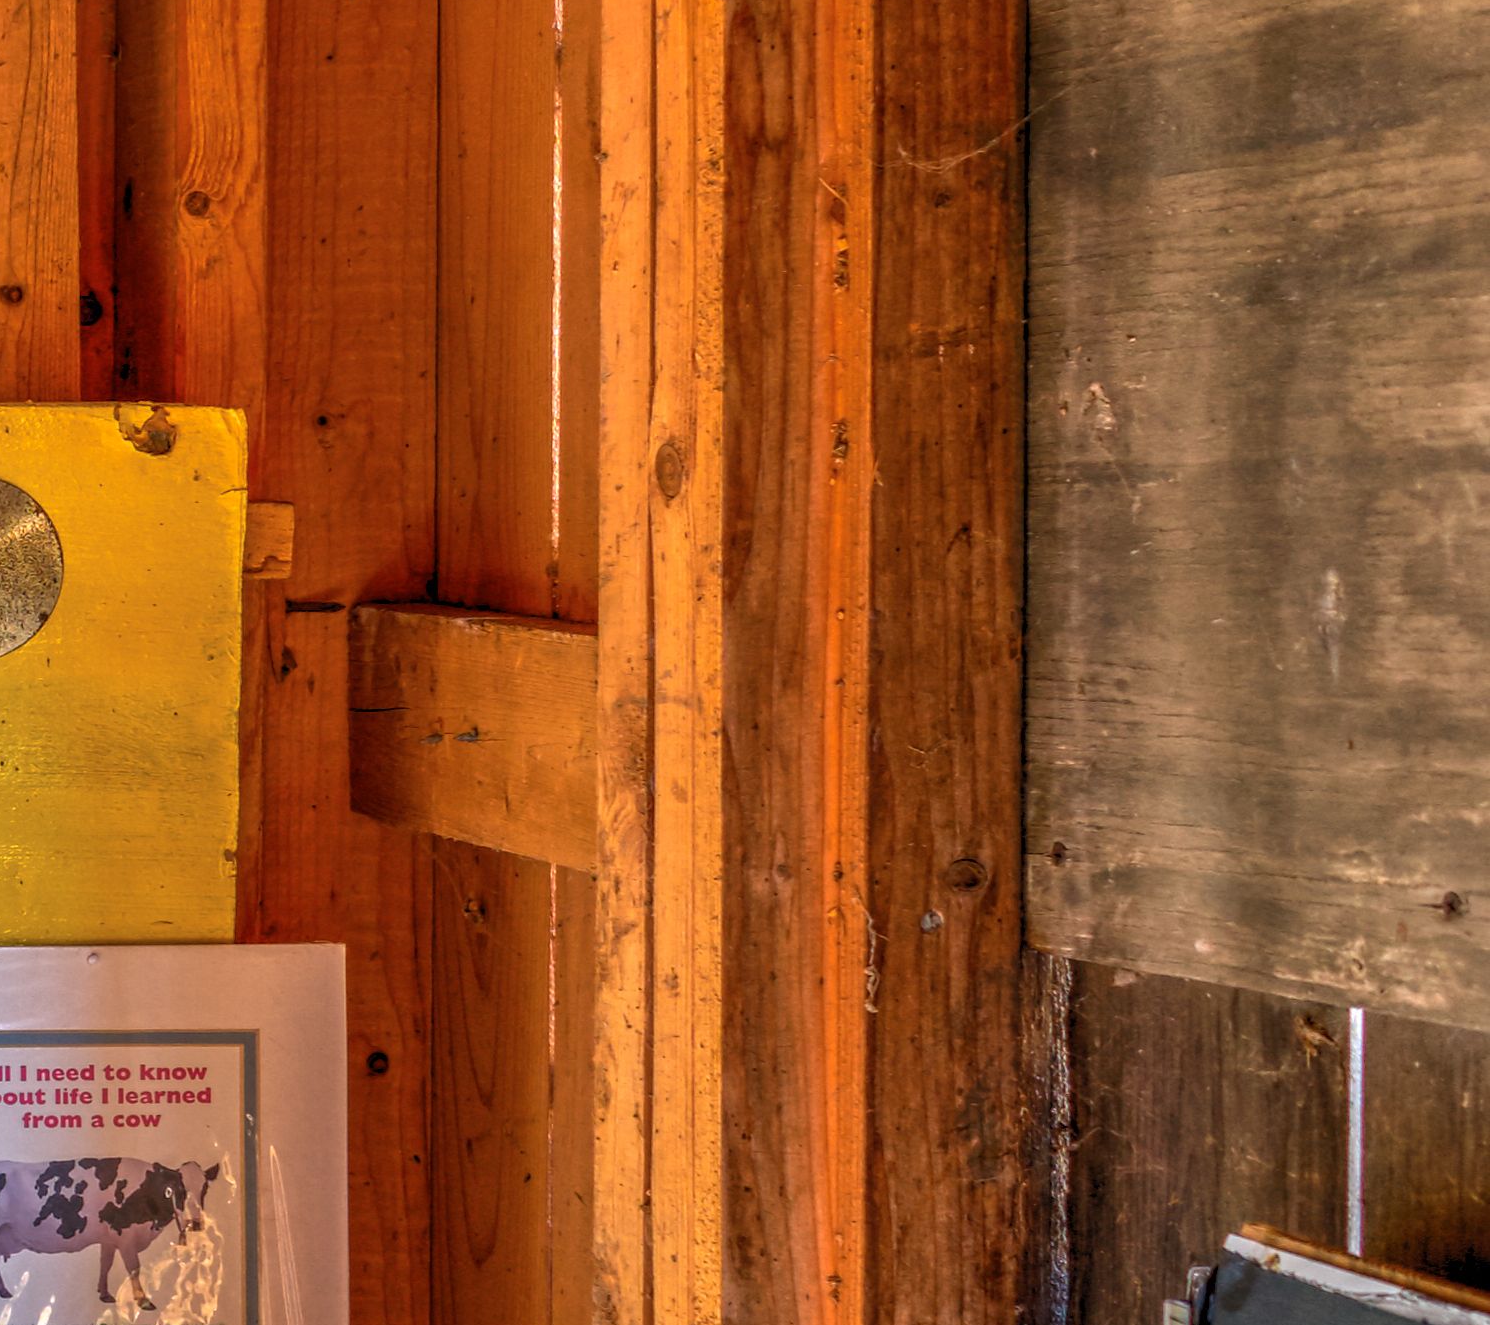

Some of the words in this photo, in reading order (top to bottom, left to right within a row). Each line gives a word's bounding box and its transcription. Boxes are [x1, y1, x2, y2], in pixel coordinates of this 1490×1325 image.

[20, 1064, 27, 1081] I
[36, 1063, 96, 1082] need
[102, 1064, 130, 1082] to
[139, 1063, 208, 1081] know
[54, 1087, 93, 1105] life
[101, 1087, 108, 1104] I
[117, 1086, 212, 1104] learned
[22, 1110, 83, 1129] from
[91, 1114, 104, 1128] a
[113, 1112, 162, 1128] cow
